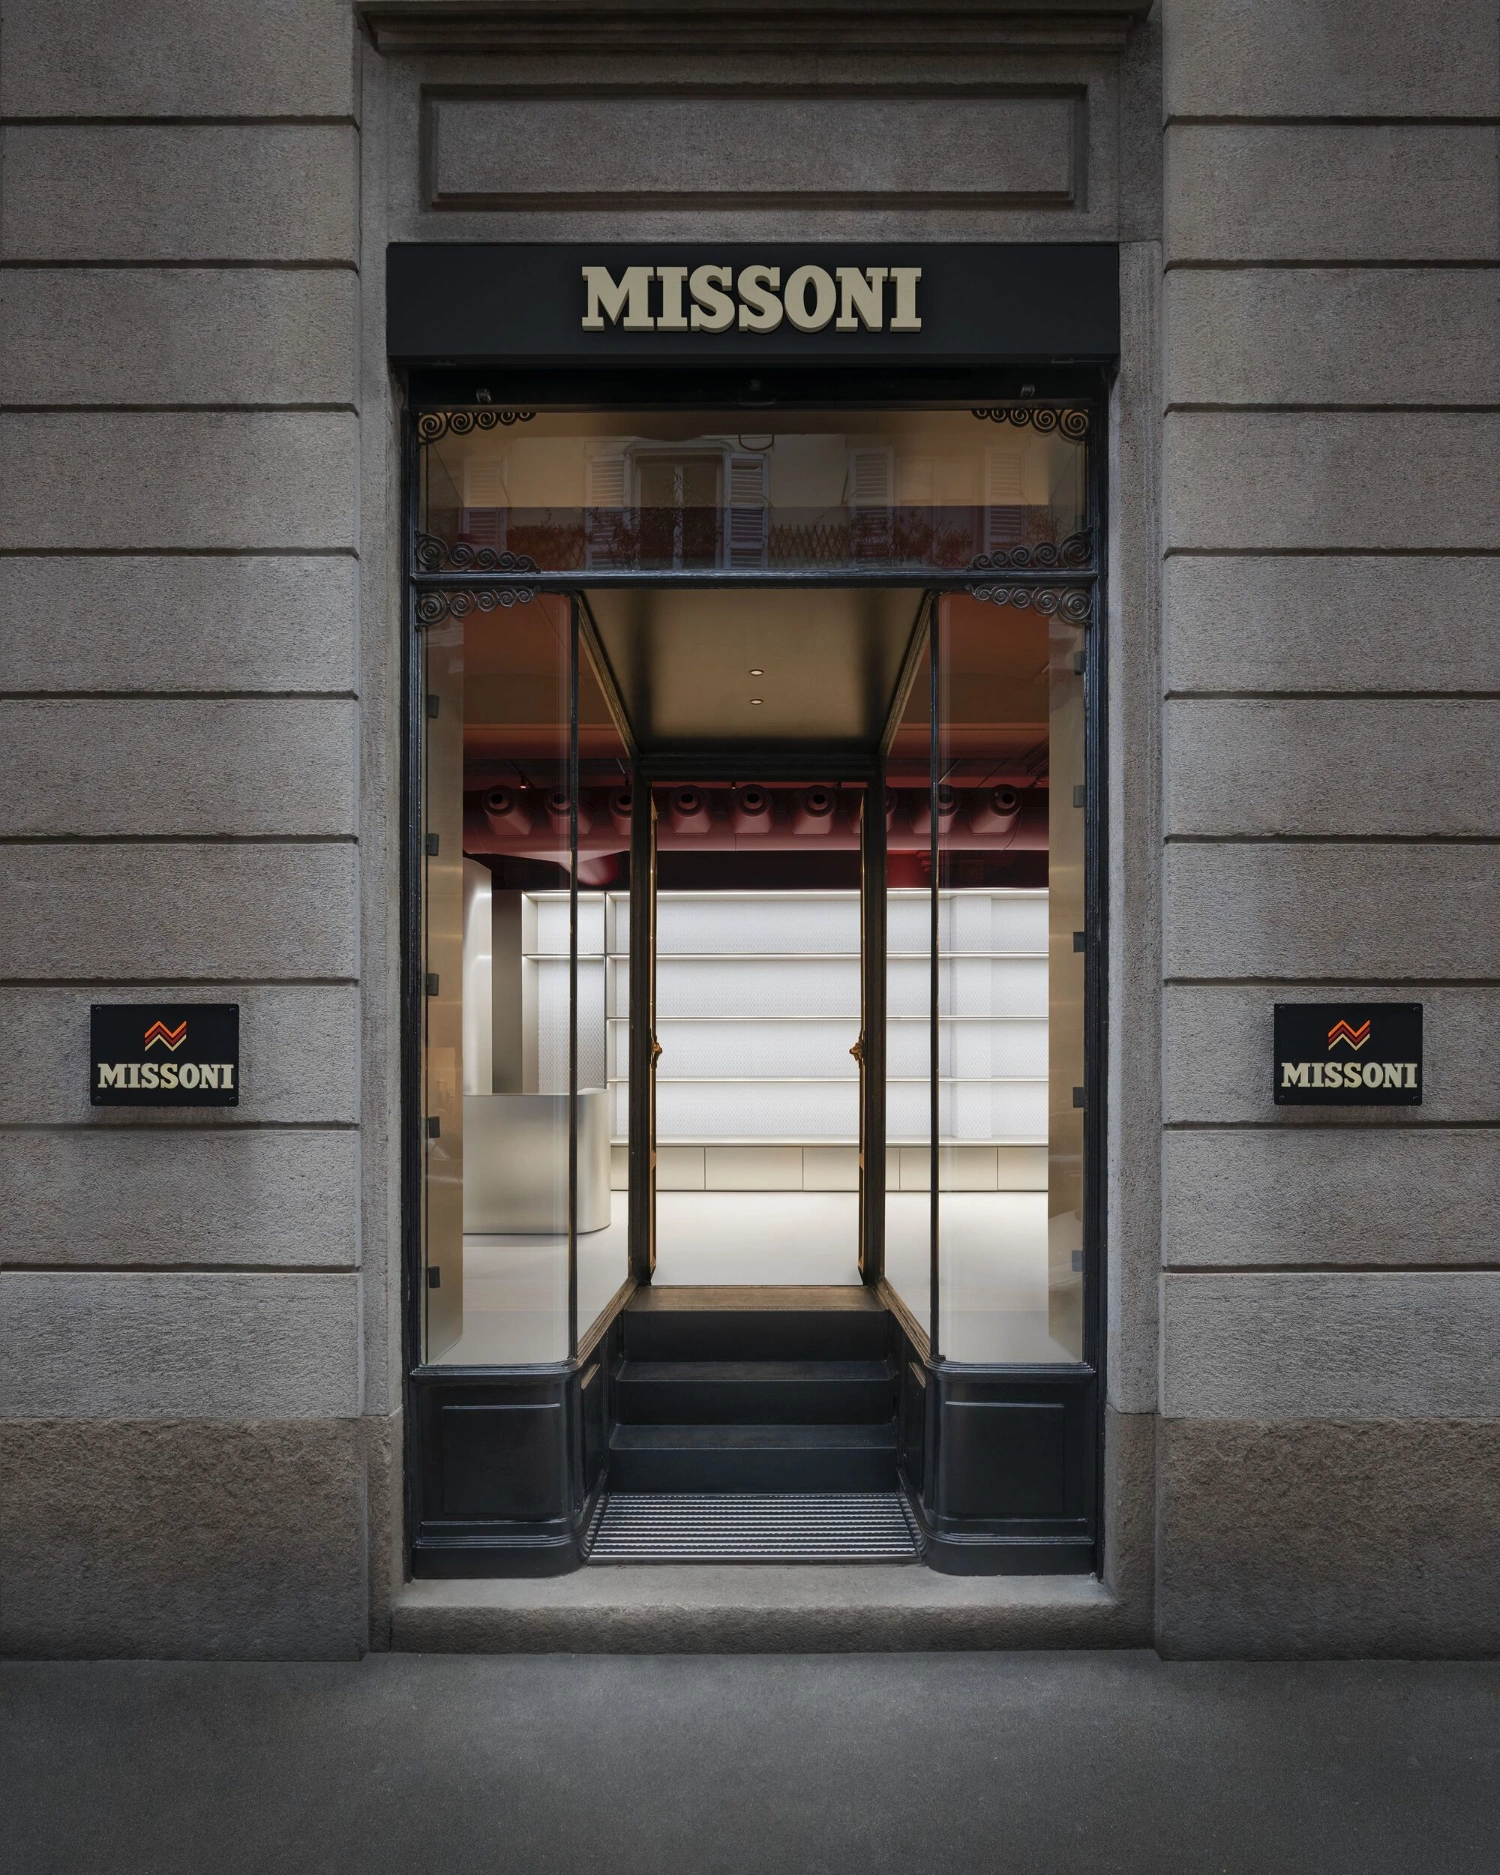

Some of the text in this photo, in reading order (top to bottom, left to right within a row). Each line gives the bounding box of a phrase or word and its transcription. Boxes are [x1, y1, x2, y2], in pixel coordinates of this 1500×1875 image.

[581, 264, 923, 333] MISSONI
[97, 1062, 235, 1090] MISSONI
[1280, 1061, 1418, 1089] MISSONI
